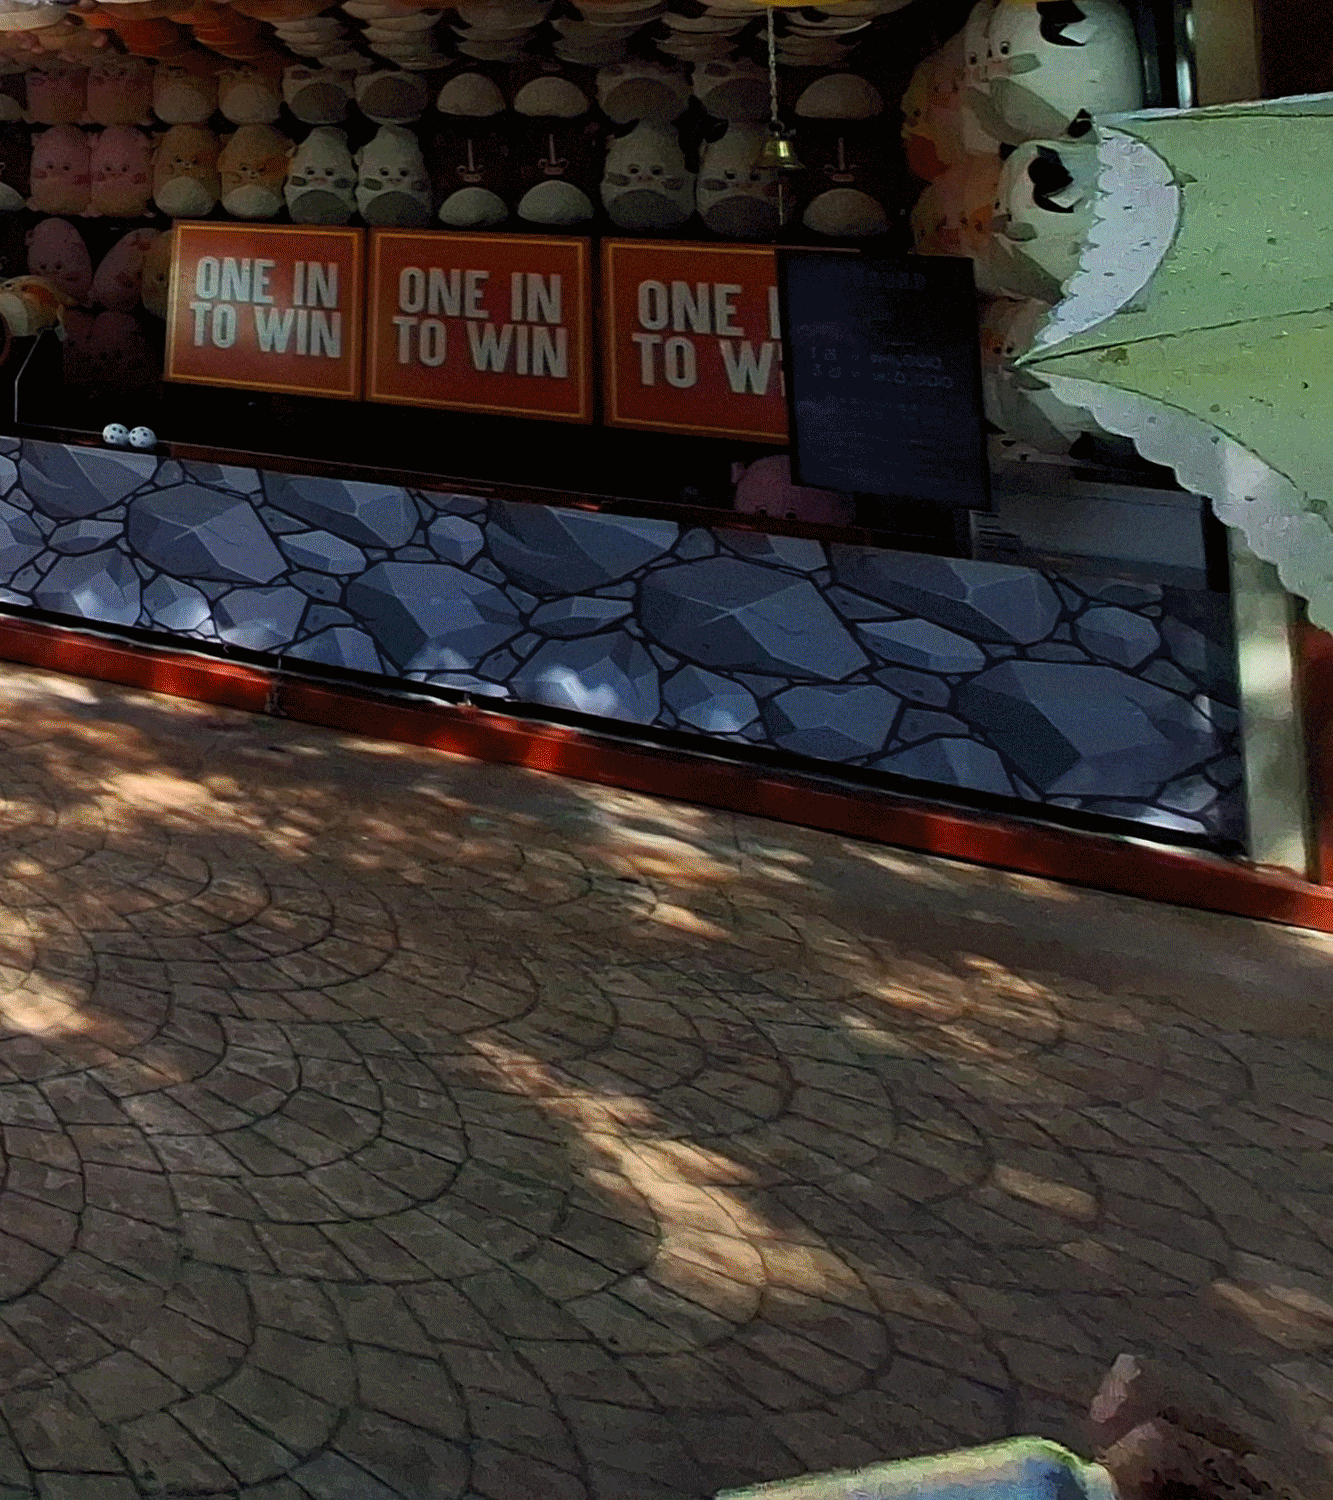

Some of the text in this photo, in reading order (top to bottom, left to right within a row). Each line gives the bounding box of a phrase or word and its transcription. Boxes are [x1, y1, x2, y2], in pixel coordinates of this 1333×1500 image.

[196, 256, 338, 308] ONE IN
[398, 266, 562, 324] ONE IN
[638, 279, 782, 339] ONE I
[189, 301, 342, 358] TO WIN
[392, 316, 568, 378] TO WIN
[632, 332, 697, 388] TO
